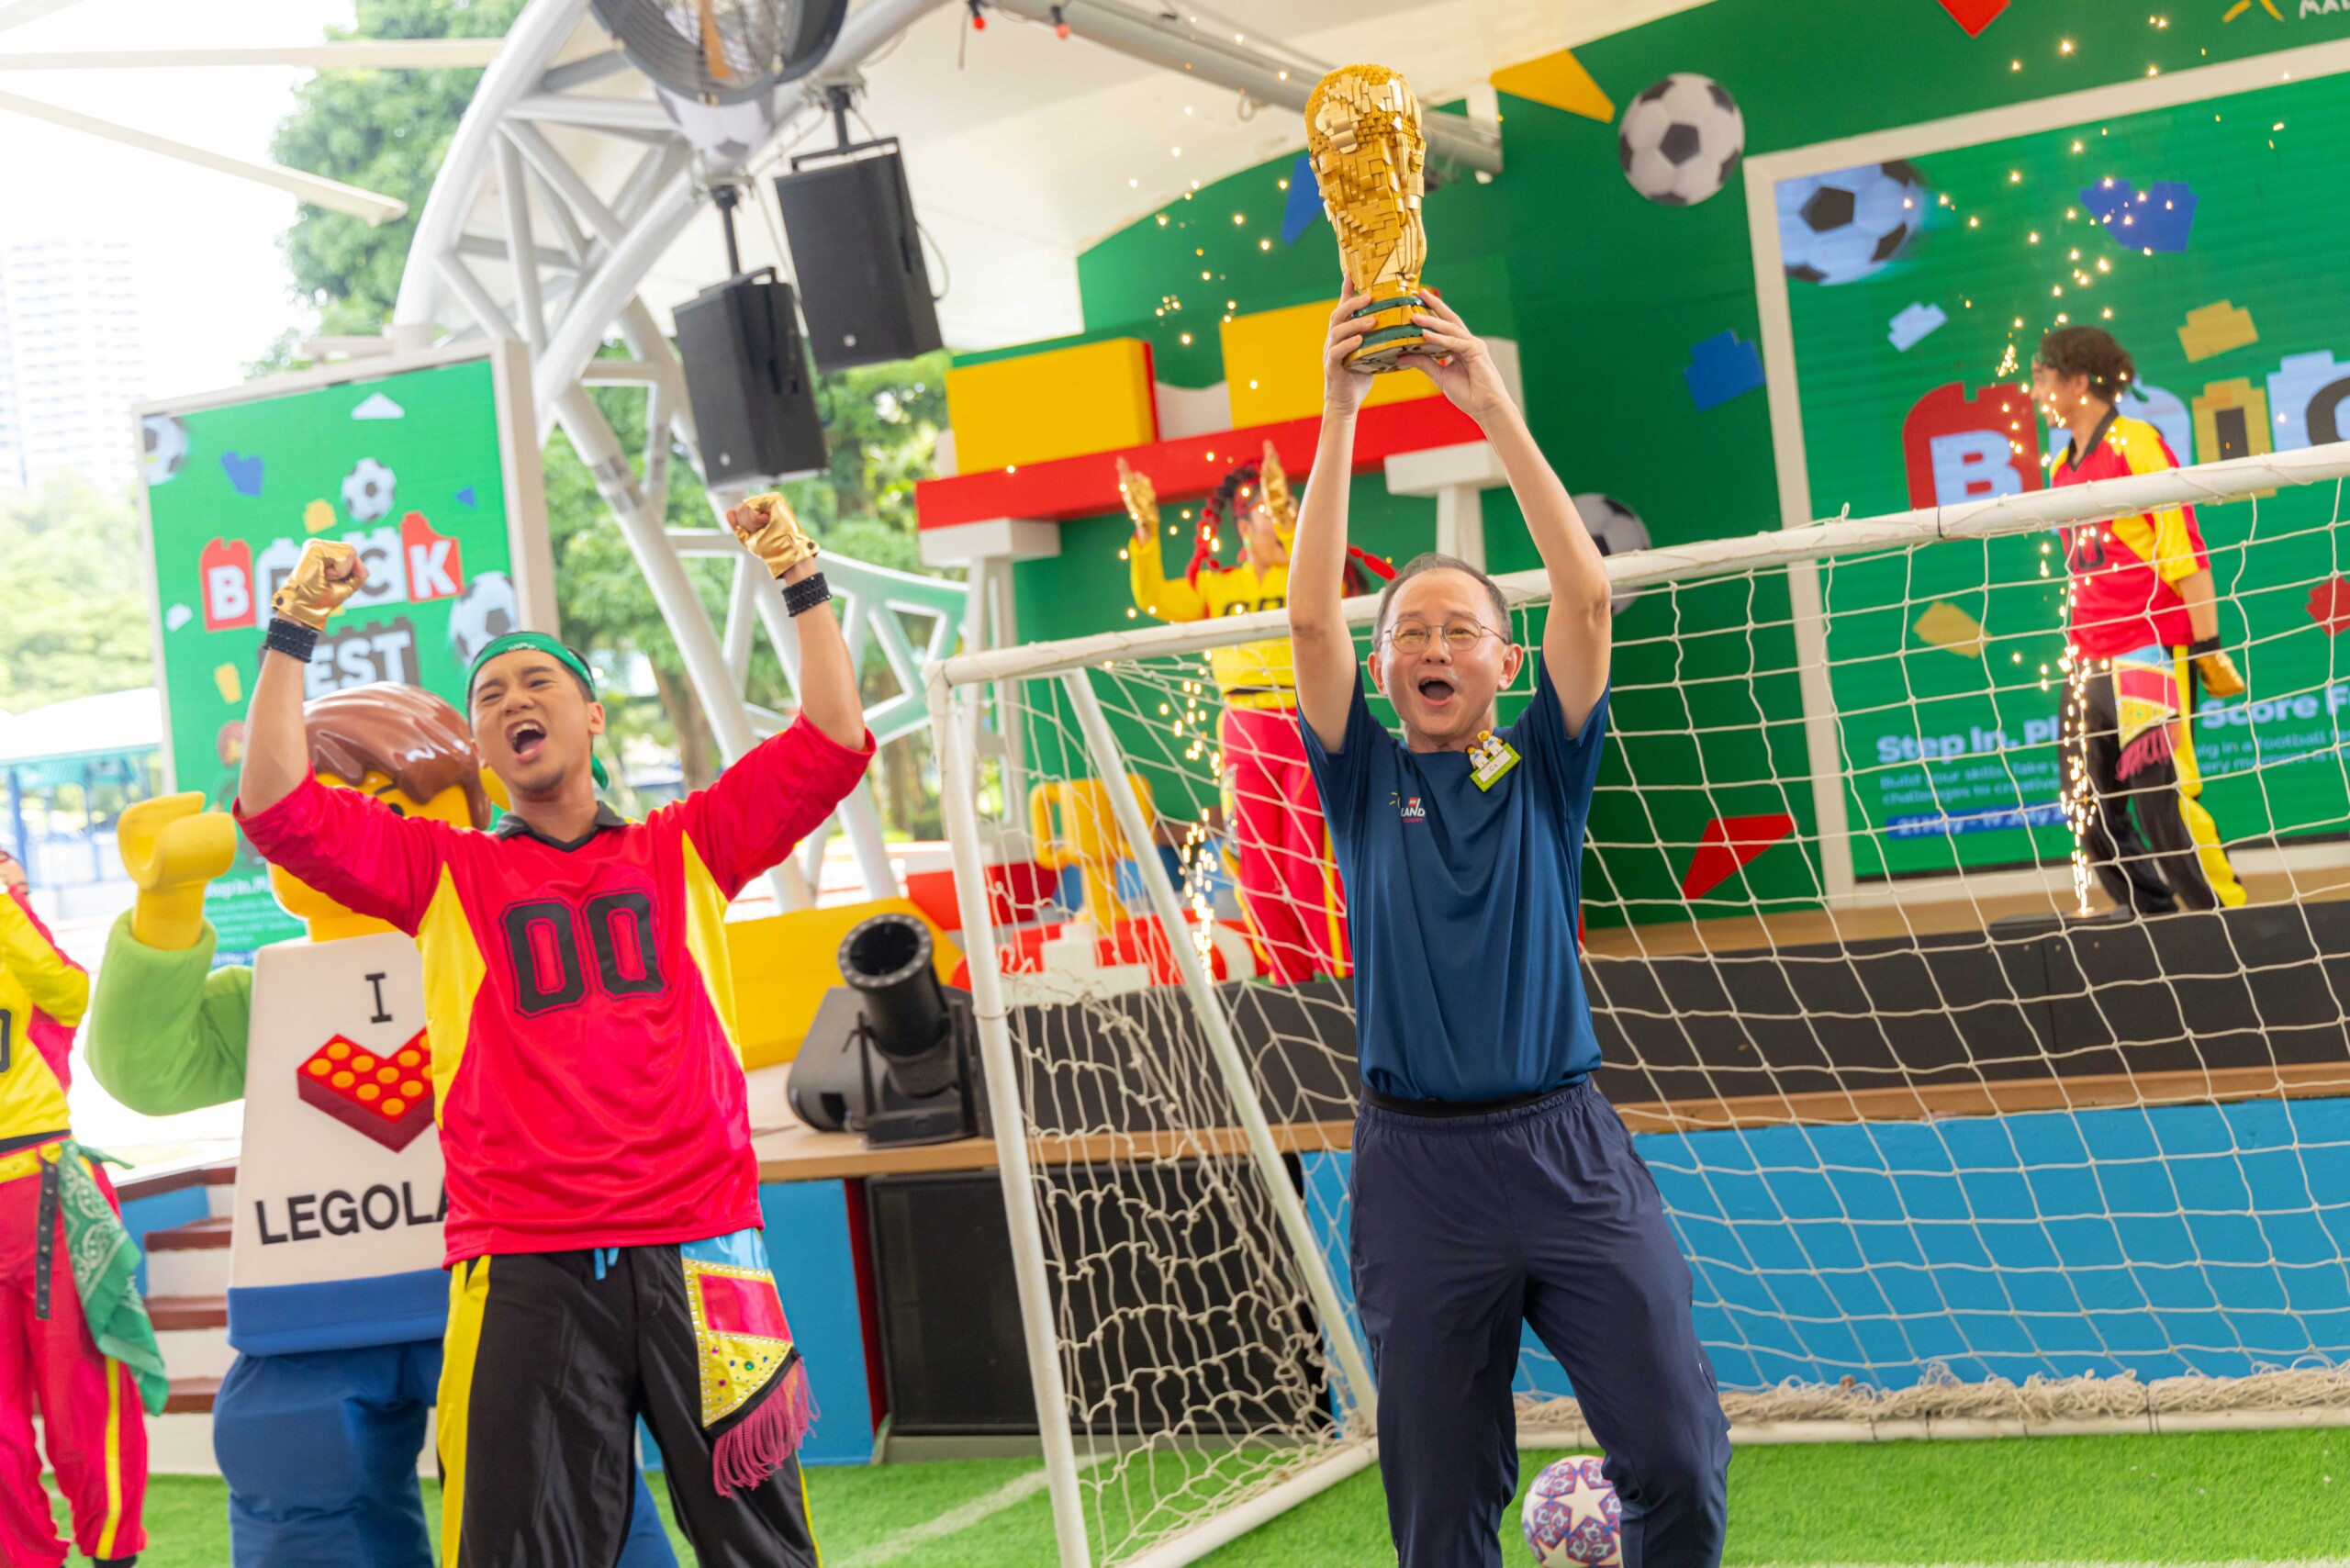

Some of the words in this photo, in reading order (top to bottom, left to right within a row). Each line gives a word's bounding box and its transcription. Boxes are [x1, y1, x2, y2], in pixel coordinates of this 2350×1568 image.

[304, 631, 411, 700] EST
[1876, 734, 1966, 765] Step
[2199, 695, 2320, 729] Score
[499, 887, 671, 1019] 00
[364, 971, 394, 1025] I
[255, 1181, 448, 1246] LEGOL
